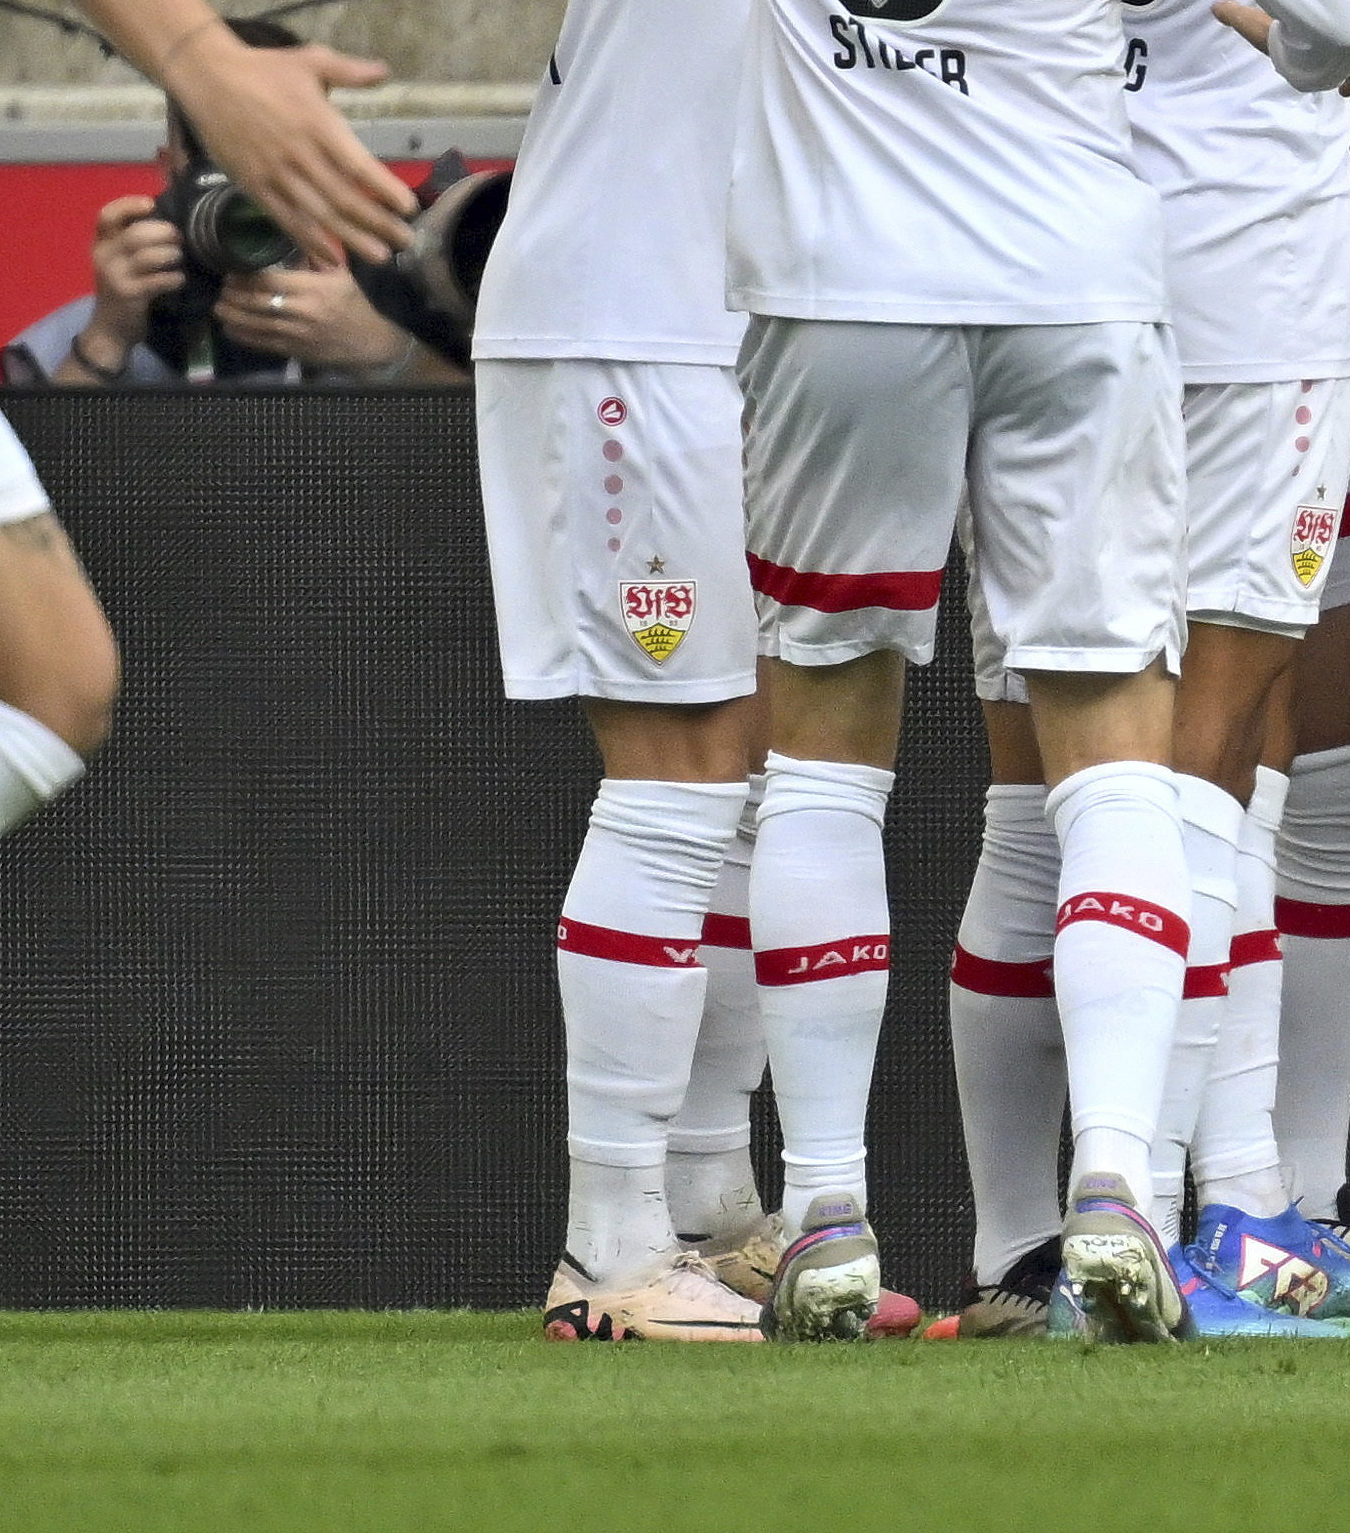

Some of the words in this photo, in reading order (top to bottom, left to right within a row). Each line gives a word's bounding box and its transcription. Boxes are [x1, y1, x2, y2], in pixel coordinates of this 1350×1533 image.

[624, 585, 693, 621] VfB
[1058, 896, 1163, 932] JAKO
[788, 942, 888, 974] JAKO
